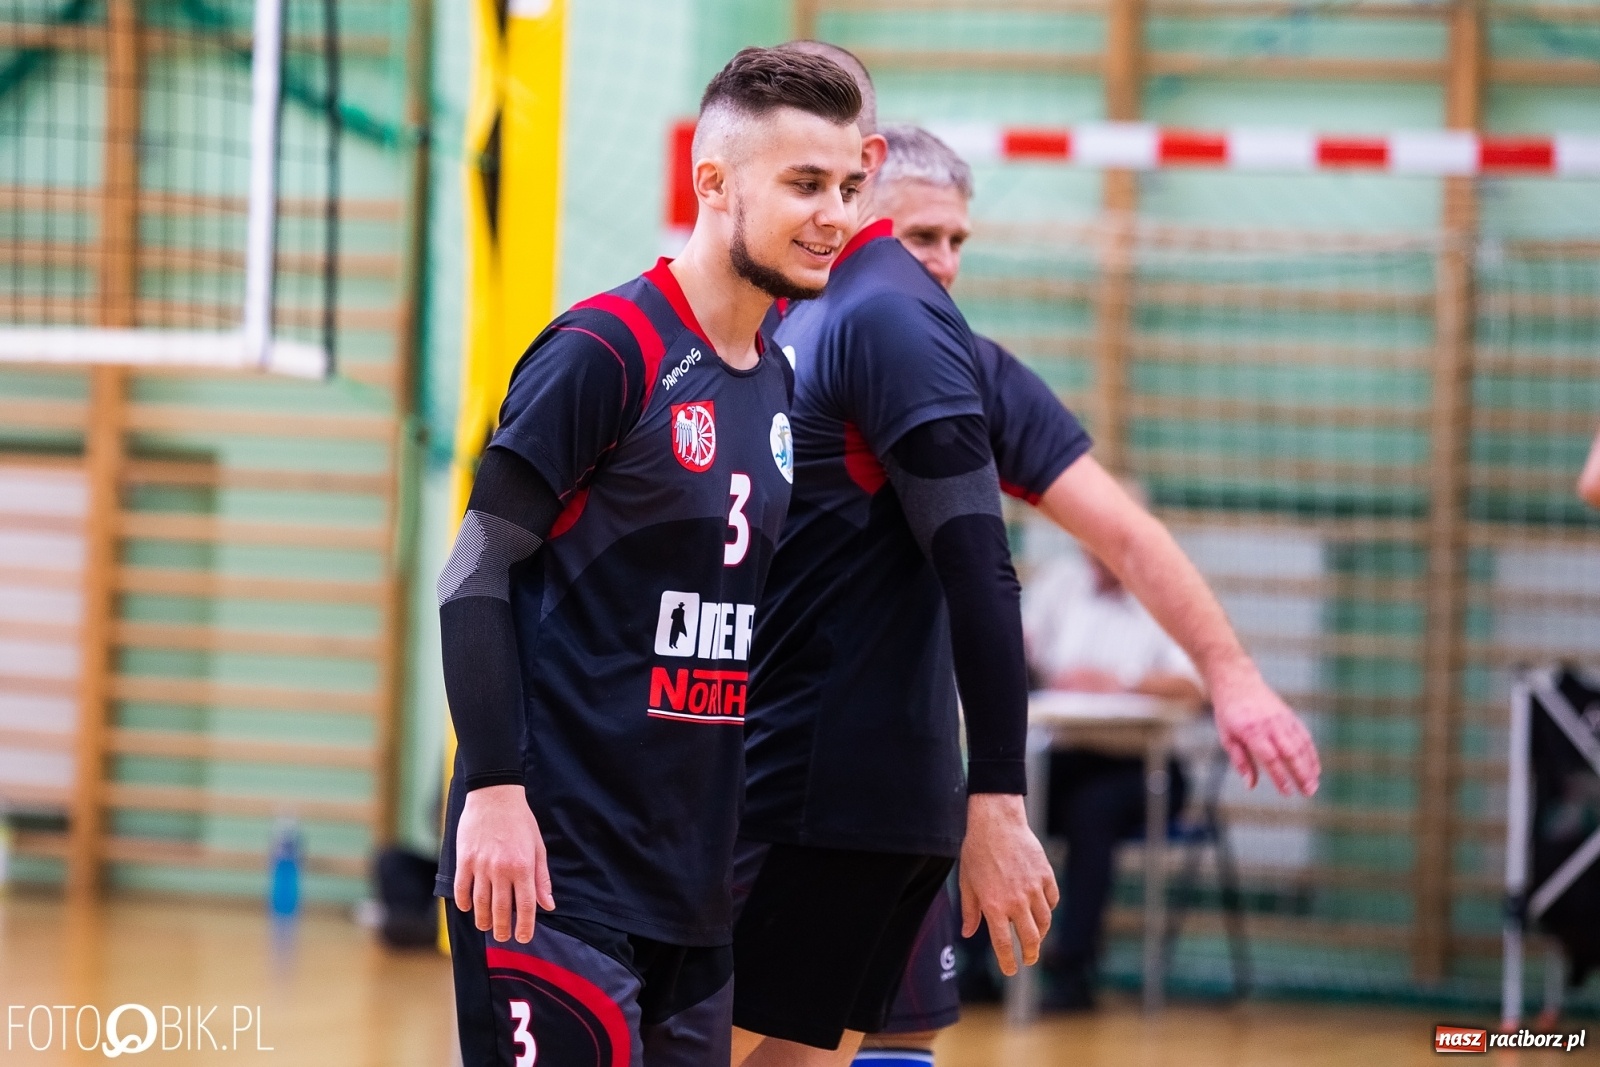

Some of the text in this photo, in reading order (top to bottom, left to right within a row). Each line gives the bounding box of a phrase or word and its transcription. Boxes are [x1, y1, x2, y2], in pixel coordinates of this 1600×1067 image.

[723, 471, 752, 567] 3
[649, 666, 749, 716] NORTH
[508, 999, 537, 1067] 3
